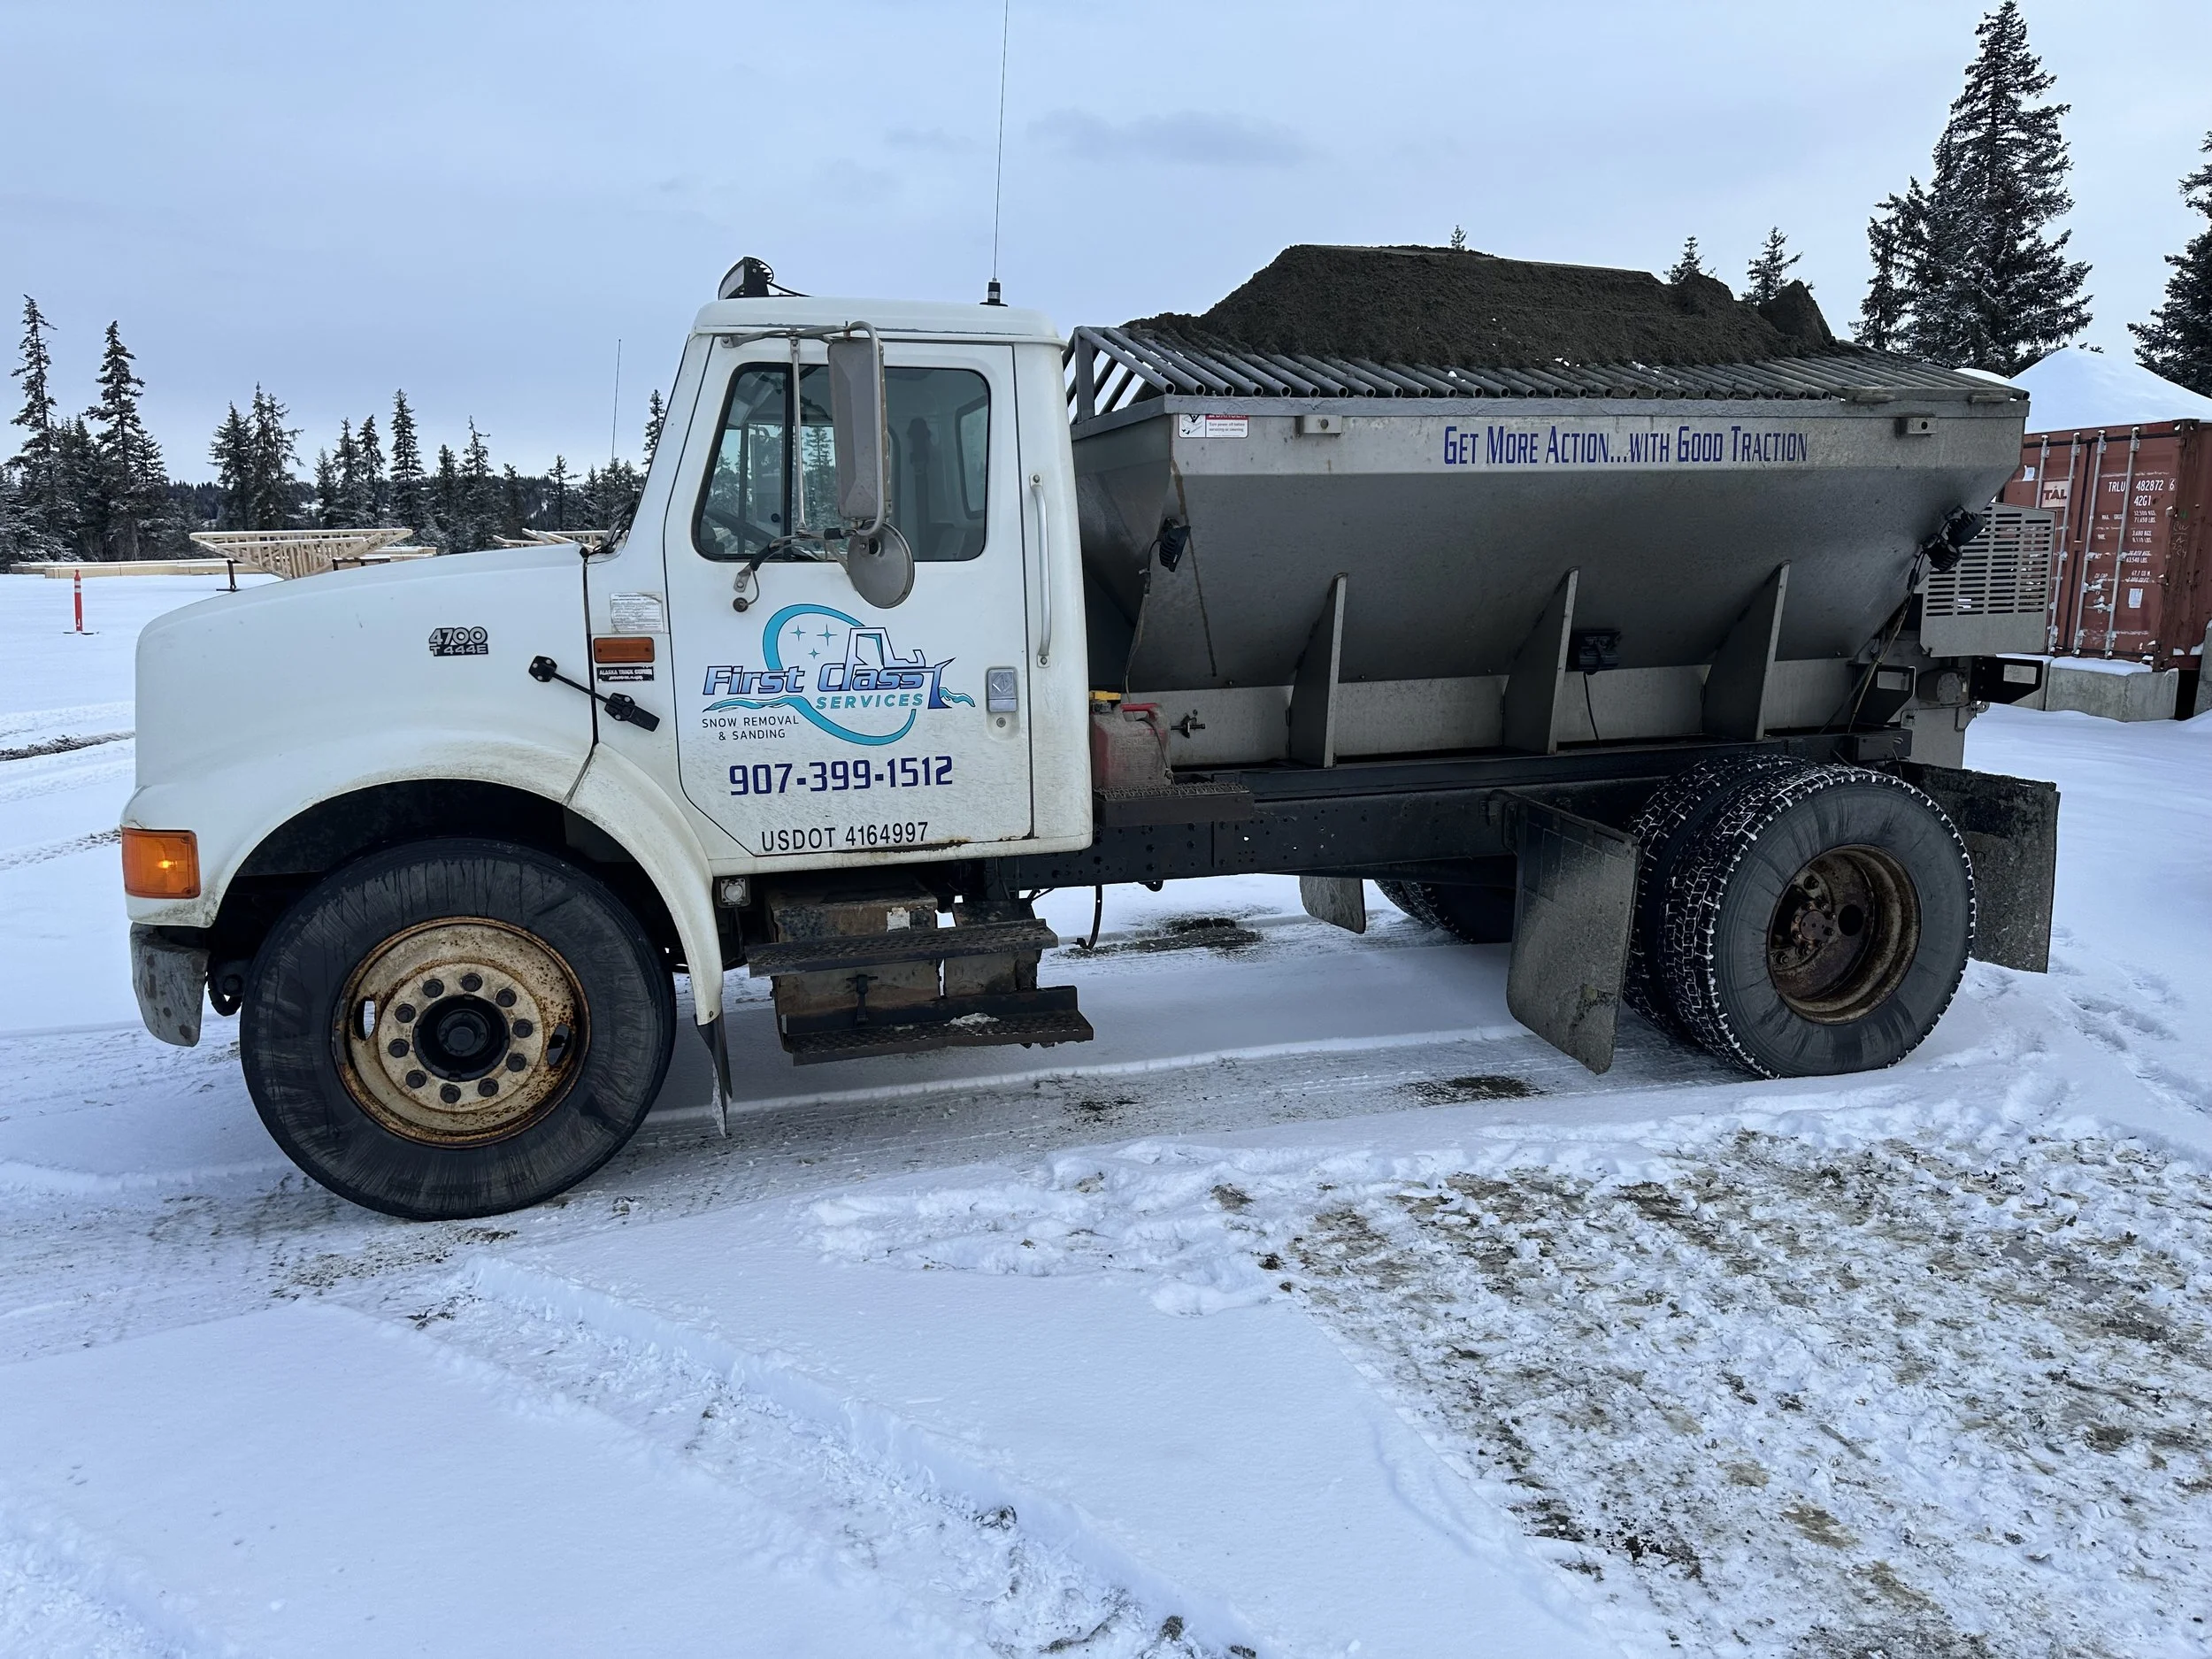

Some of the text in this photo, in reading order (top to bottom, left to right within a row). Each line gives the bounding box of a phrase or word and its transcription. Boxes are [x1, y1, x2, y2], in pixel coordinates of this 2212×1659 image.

[1444, 426, 1479, 465] GET
[1486, 426, 1539, 465] MORE
[1678, 426, 1724, 463] GOOD
[1731, 426, 1808, 462] TRACTION
[2108, 479, 2176, 493] TRLU 482872 6
[2043, 488, 2067, 501] TAL
[2133, 495, 2152, 507] 42G1
[429, 626, 488, 645] 4700
[430, 644, 488, 656] T 444E
[703, 658, 926, 695] First Class
[816, 693, 924, 710] SERVICES
[702, 714, 800, 728] SNOW REMOVAL
[718, 728, 786, 741] & SANDING
[729, 756, 954, 796] 907-399-1512
[761, 821, 930, 852] USDOT 4164997
